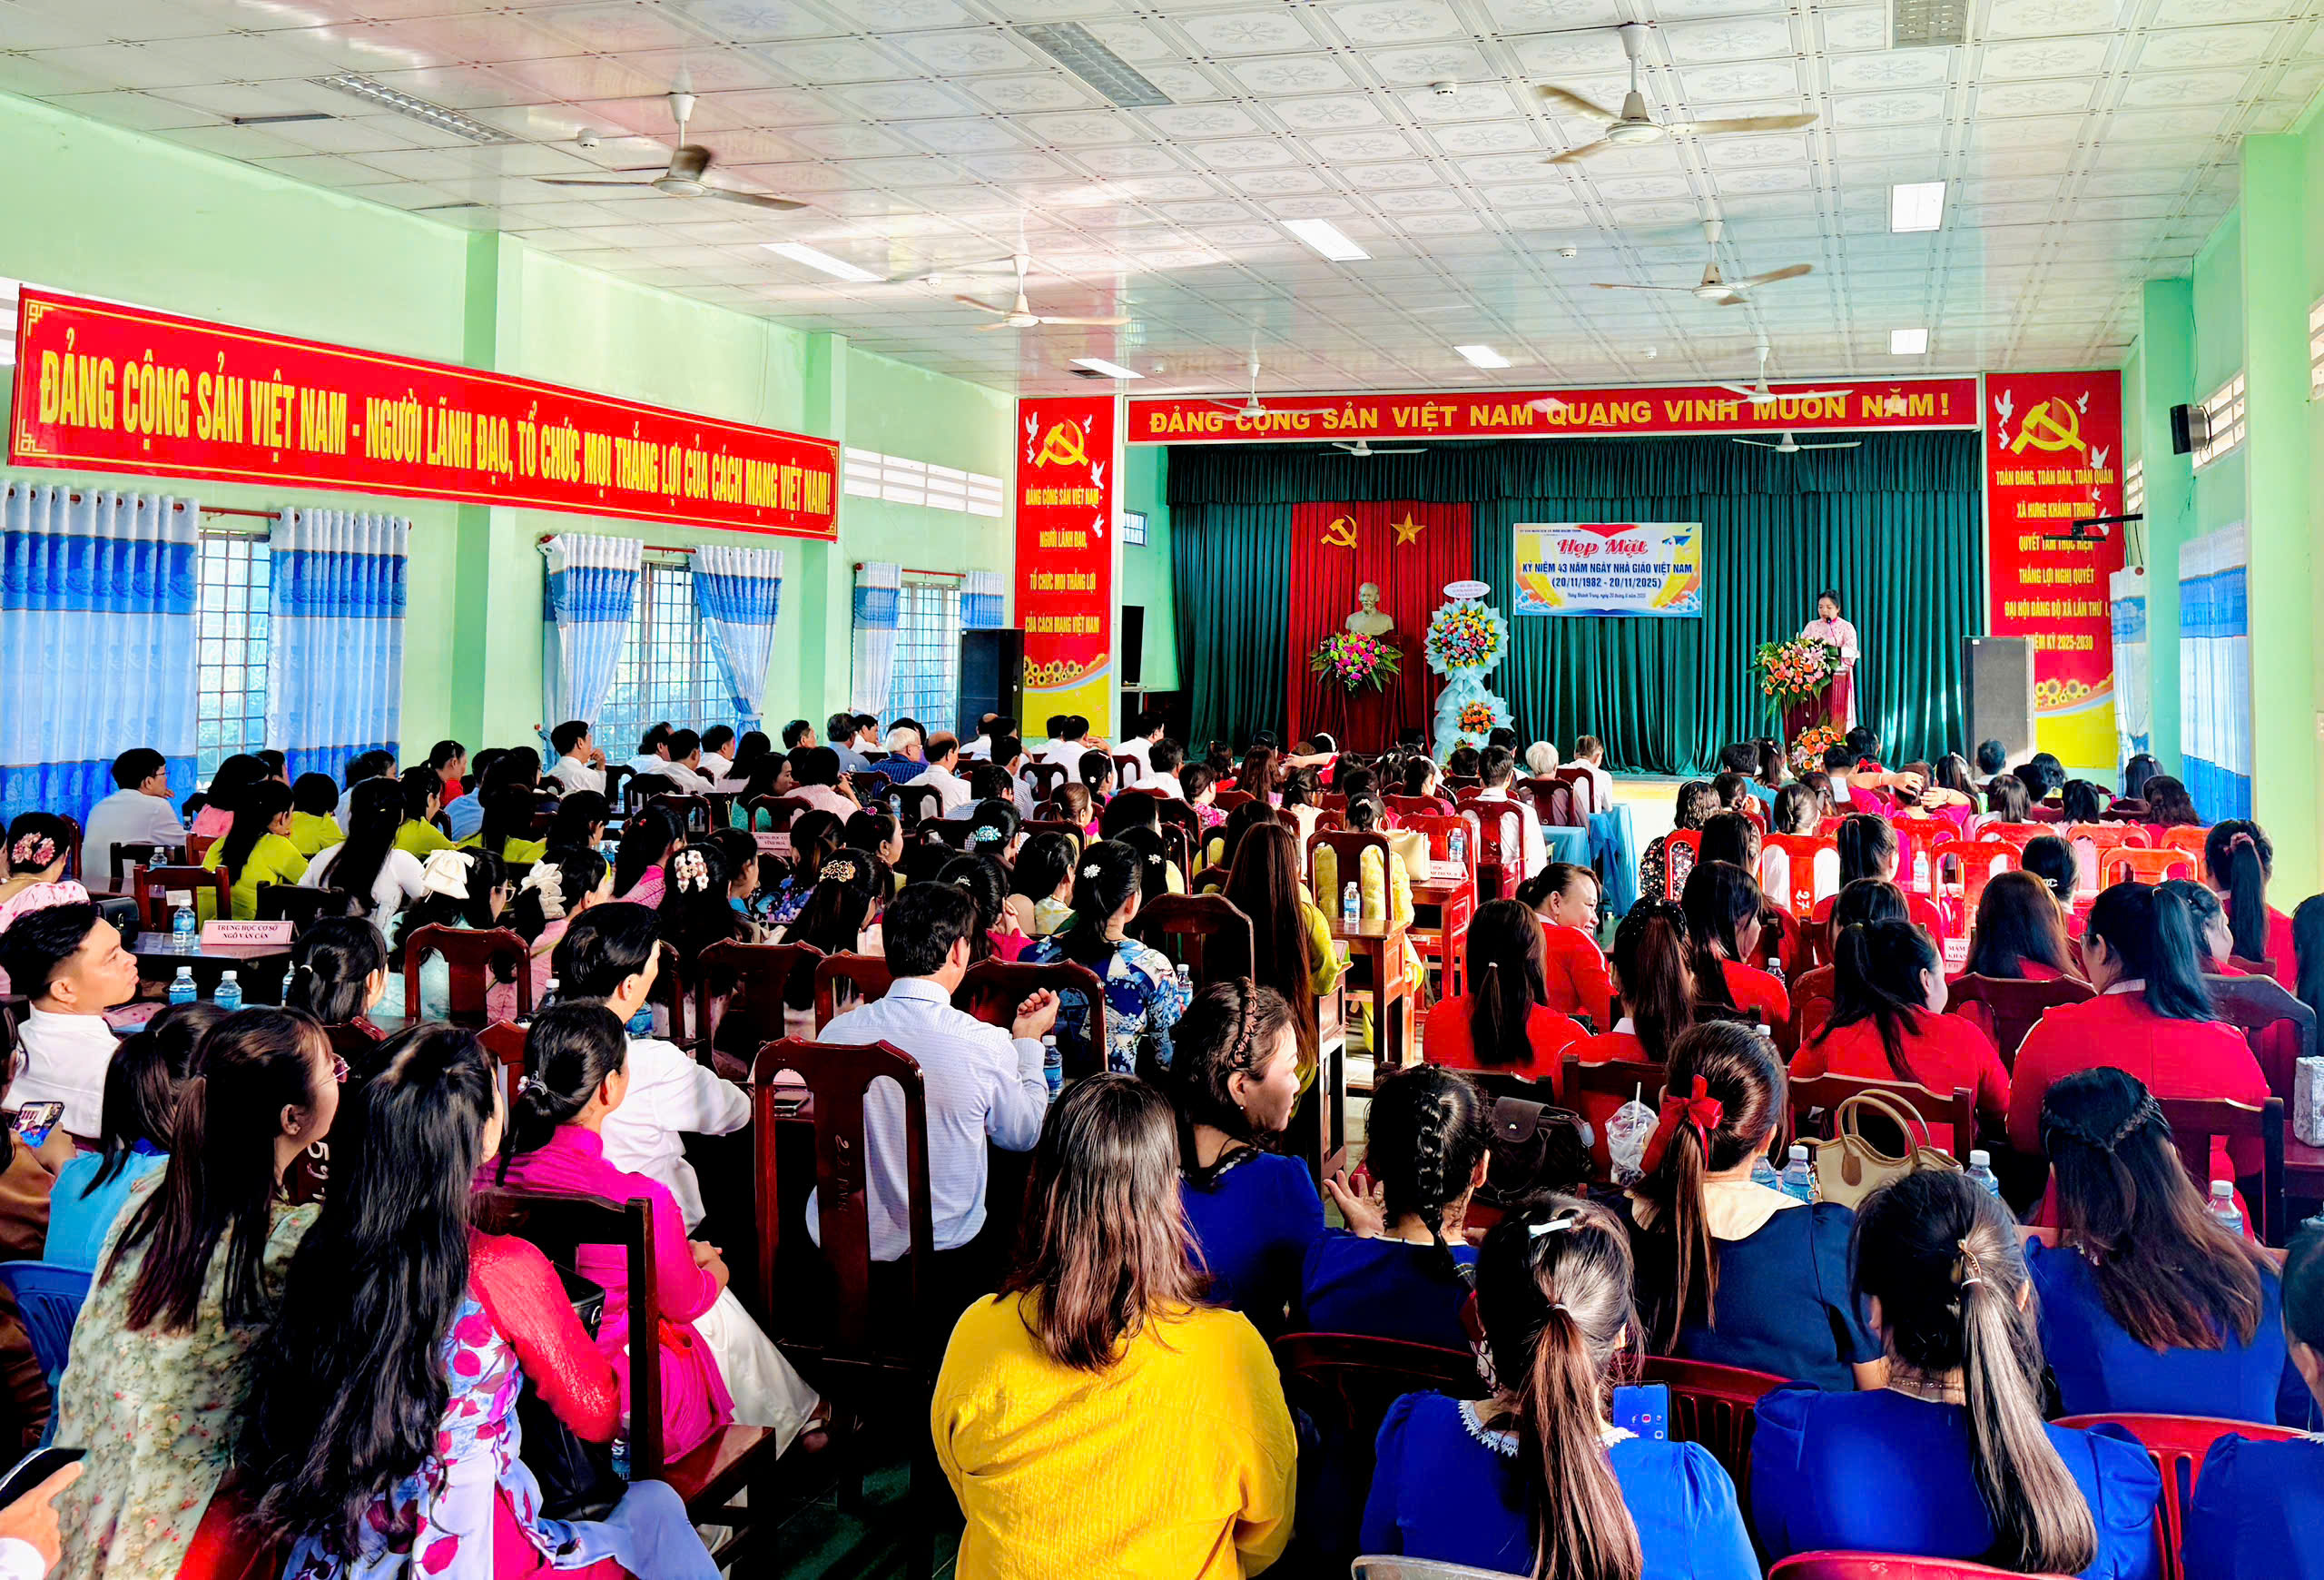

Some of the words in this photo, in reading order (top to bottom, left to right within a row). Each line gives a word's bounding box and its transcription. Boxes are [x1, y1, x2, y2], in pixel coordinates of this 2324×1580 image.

[1148, 405, 1224, 433] ĐẢNG
[1235, 405, 1310, 436] CỘNG
[1322, 401, 1378, 430] SẢN
[1392, 401, 1457, 433] VIỆT
[1470, 404, 1533, 427] NAM
[1546, 400, 1651, 427] QUANG
[1663, 398, 1738, 423] VINH
[1862, 387, 1935, 419] NĂM
[39, 327, 114, 430] ĐẢNG
[123, 348, 189, 450] CỘNG
[196, 351, 243, 444] SẢN
[250, 369, 295, 462] VIỆT
[300, 387, 347, 455] NAM
[365, 387, 422, 464] NGƯỜI
[427, 396, 472, 469] LÃNH
[476, 415, 514, 485] ĐẠO,
[517, 400, 537, 478] TỔ
[540, 416, 580, 483] CHỨC
[584, 431, 611, 498] MỌI
[615, 420, 658, 493] THẮNG
[662, 441, 681, 507] LỢI
[684, 432, 708, 500] CỦA
[711, 444, 743, 504] CÁCH
[745, 459, 778, 517] MẠNG
[780, 457, 803, 521] VIỆT
[804, 469, 832, 516] NAM!
[1996, 467, 2014, 486] TOÀN
[2037, 467, 2055, 485] TOÀN
[2074, 466, 2093, 485] TOÀN
[2094, 465, 2113, 486] QUÂN
[1043, 485, 1059, 509] CỘNG
[1059, 482, 1071, 506] SẢN
[1072, 485, 1084, 509] VIỆT
[1085, 488, 1098, 506] NAM
[2017, 499, 2026, 518] XÃ
[2048, 499, 2072, 518] KHÁNH
[2073, 502, 2096, 518] TRUNG
[1557, 538, 1600, 558] Họp
[1604, 538, 1649, 558] Mặt
[2019, 531, 2040, 552] QUYẾT
[1534, 560, 1556, 575] NIỆM
[1557, 563, 1568, 573] 43
[1569, 561, 1588, 573] NĂM
[1590, 560, 1611, 574] NGÀY
[1613, 560, 1630, 574] NHÀ
[1631, 560, 1651, 574] GIÁO
[1653, 560, 1670, 576] VIỆT
[1672, 563, 1692, 574] NAM
[2019, 563, 2041, 584] THẮNG
[2043, 567, 2053, 587] LỢI
[2054, 568, 2072, 587] NGHỊ
[2073, 564, 2094, 585] QUYẾT
[1551, 577, 1602, 589] (20/11/1982
[1609, 577, 1662, 589] 20/11/2025)
[2004, 600, 2016, 620] ĐẠI
[2017, 597, 2030, 620] HỘI
[2031, 596, 2050, 617] ĐẢNG
[2052, 597, 2061, 620] BỘ
[2063, 597, 2072, 617] XÃ
[1038, 613, 1053, 633] CÁCH
[1054, 616, 1071, 637] MẠNG
[1072, 613, 1085, 637] VIỆT
[1086, 616, 1099, 633] NAM
[2056, 635, 2094, 651] 2025-2030
